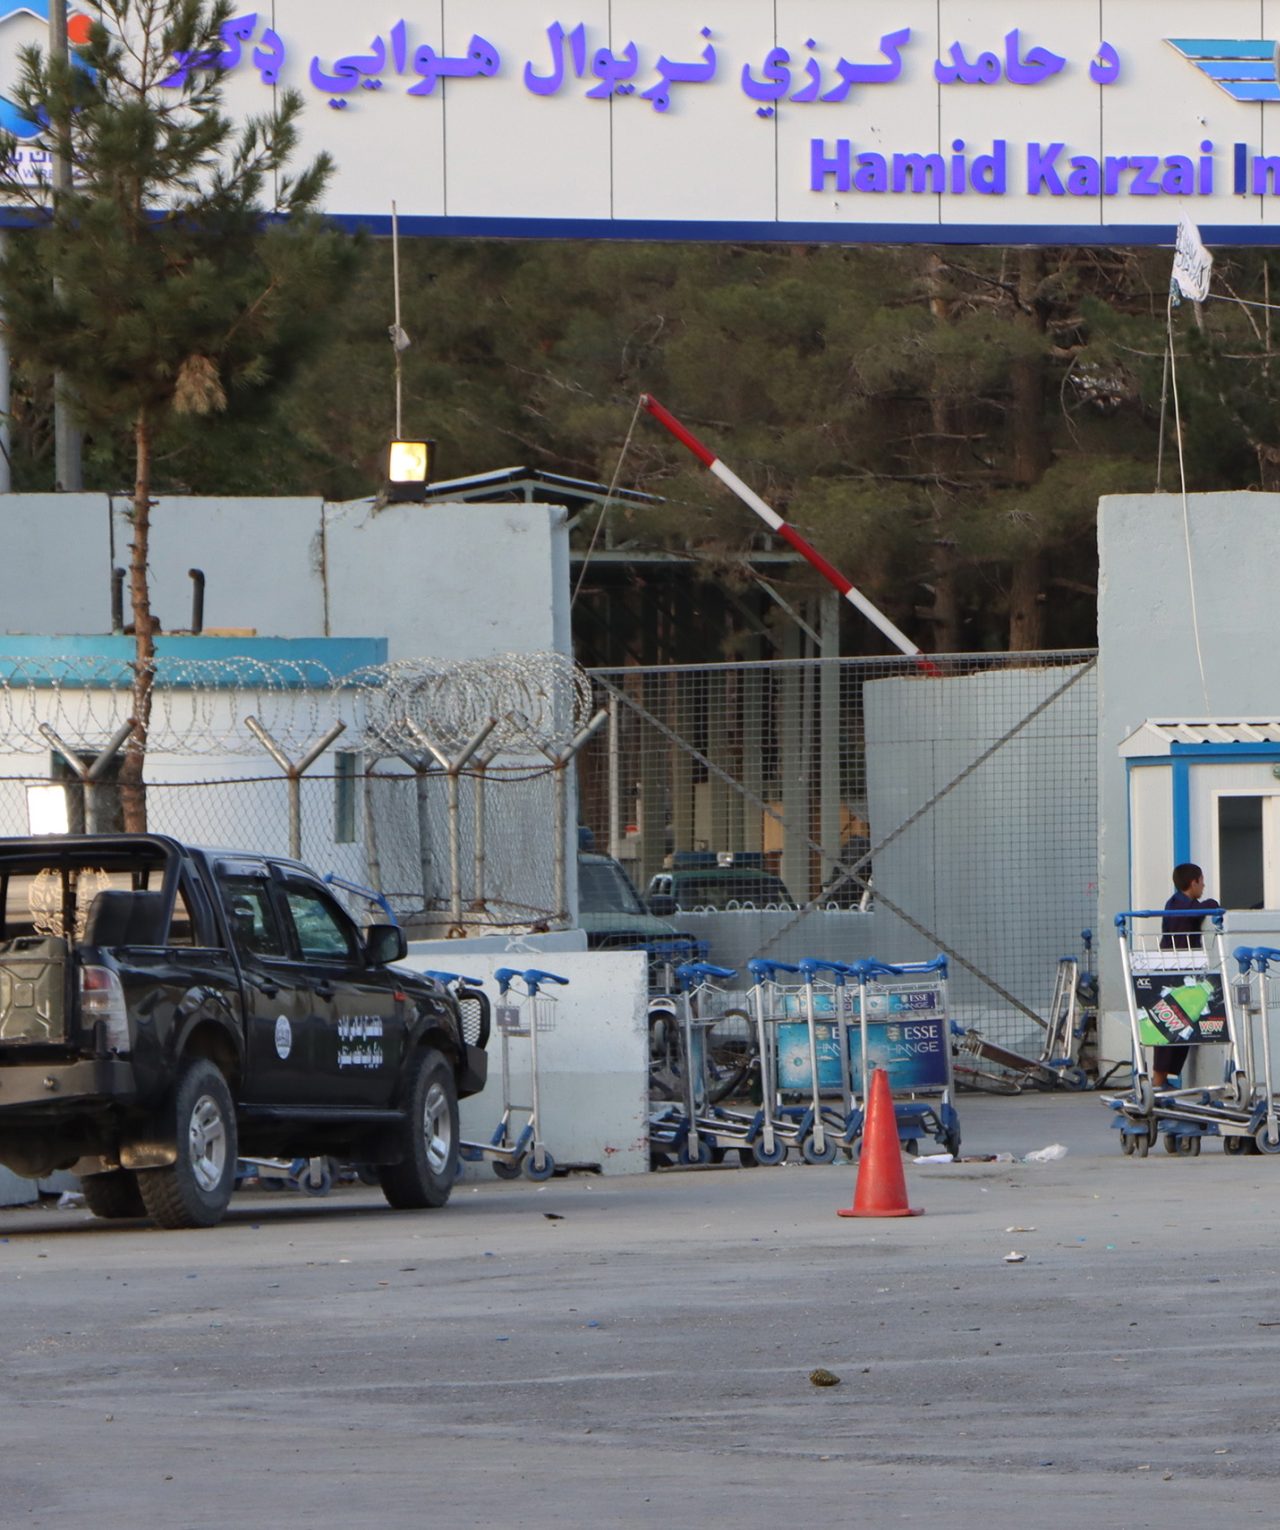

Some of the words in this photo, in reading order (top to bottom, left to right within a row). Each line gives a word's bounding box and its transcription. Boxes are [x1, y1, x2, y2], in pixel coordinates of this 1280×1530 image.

[934, 29, 1066, 85] حامد
[1090, 42, 1121, 85] د
[811, 139, 1007, 194] Hamid
[1027, 140, 1214, 196] Karzai
[904, 1025, 938, 1040] ESSE
[1153, 999, 1185, 1032] WOW
[1199, 1020, 1224, 1032] WOW
